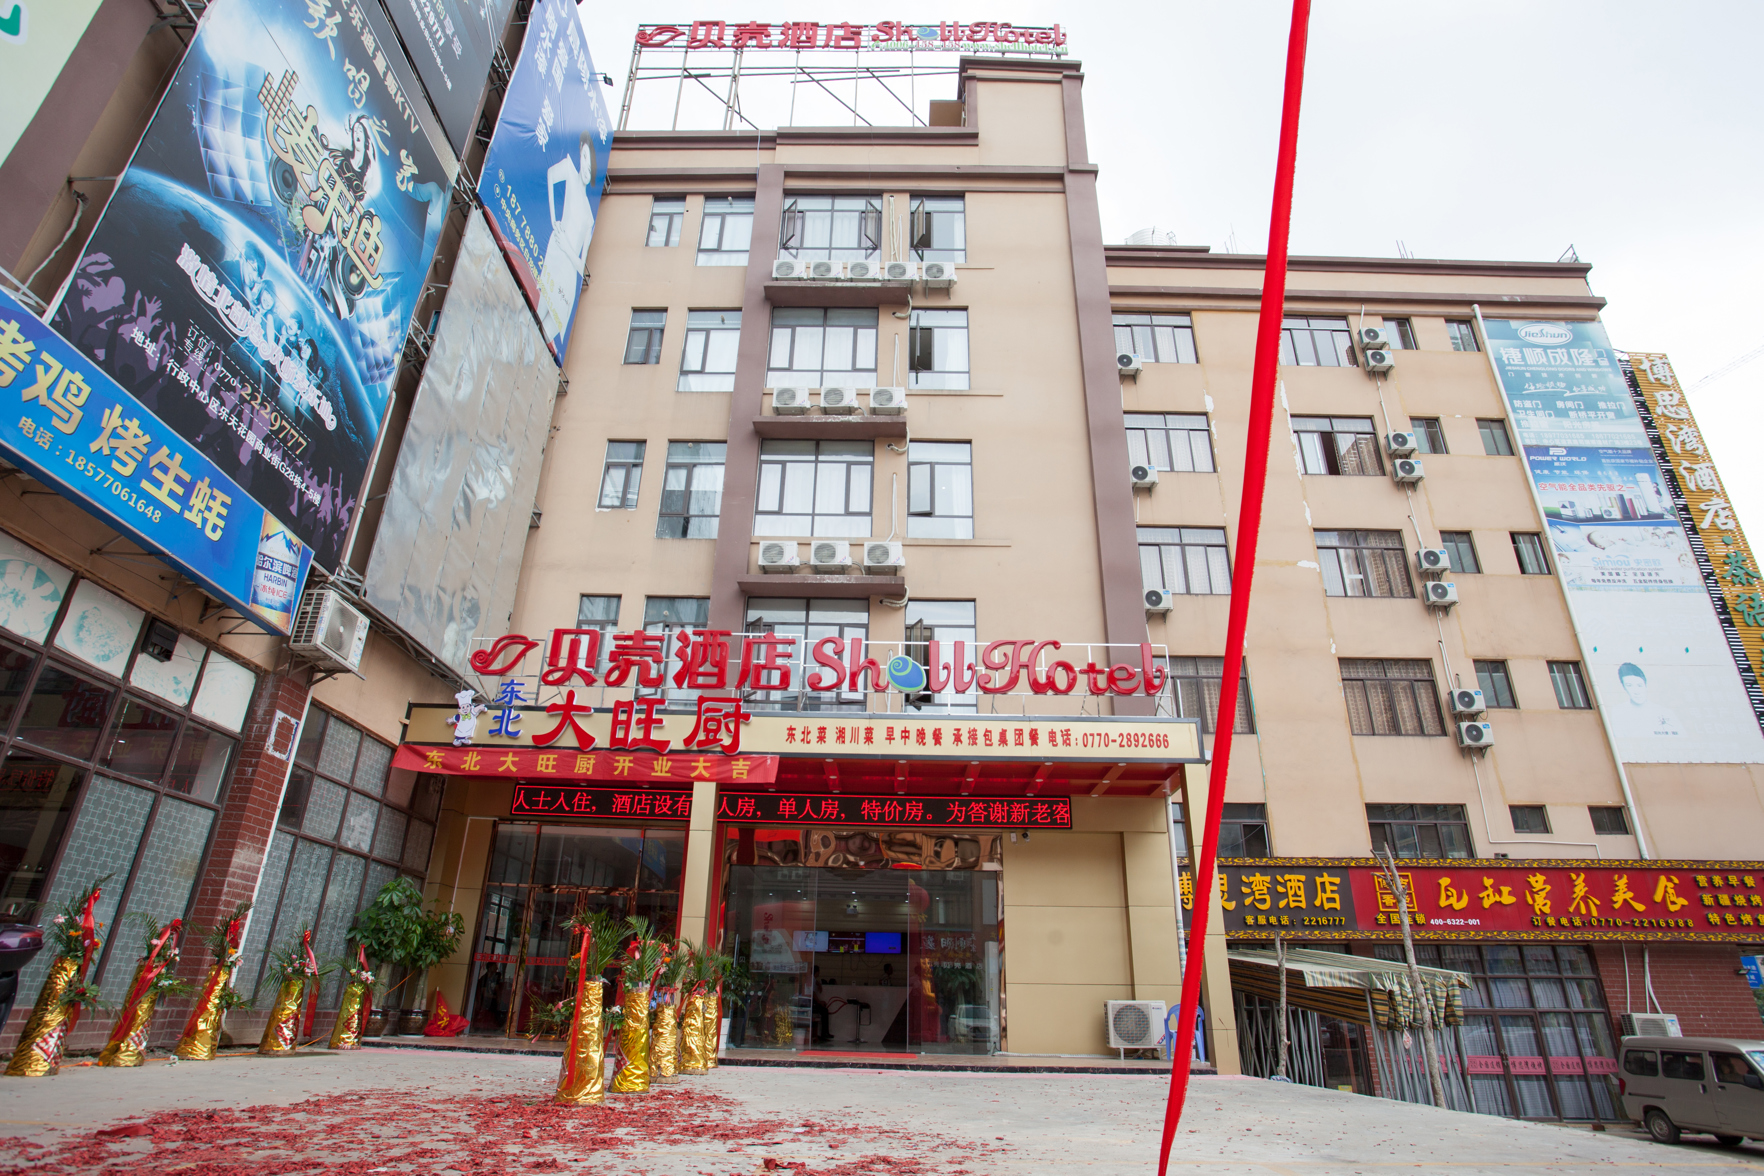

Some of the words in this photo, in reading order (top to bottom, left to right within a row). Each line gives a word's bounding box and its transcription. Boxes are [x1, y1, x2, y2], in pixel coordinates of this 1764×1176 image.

[690, 20, 863, 50] 贝壳酒店
[341, 0, 420, 133] 乐迪量贩KTV
[214, 362, 309, 455] 0770-2229777
[1637, 357, 1737, 531] 博思湾酒店
[89, 403, 232, 542] 烤生蚝
[263, 573, 288, 588] HARBIN
[540, 628, 797, 691] 贝壳酒店
[487, 679, 529, 738] 东北
[531, 690, 753, 754] 大旺厨
[786, 725, 828, 745] 东北菜
[835, 725, 875, 745] 湘川菜
[884, 726, 943, 747] 早中晚餐
[952, 727, 1040, 747] 承接包桌团餐
[423, 750, 752, 780] 东北大旺厨开业大吉
[1437, 872, 1689, 917] 瓦缸营养美食
[1695, 874, 1757, 888] 营养早餐
[1700, 893, 1763, 906] 新疆烧烤
[1429, 917, 1481, 926] 400-6322-001
